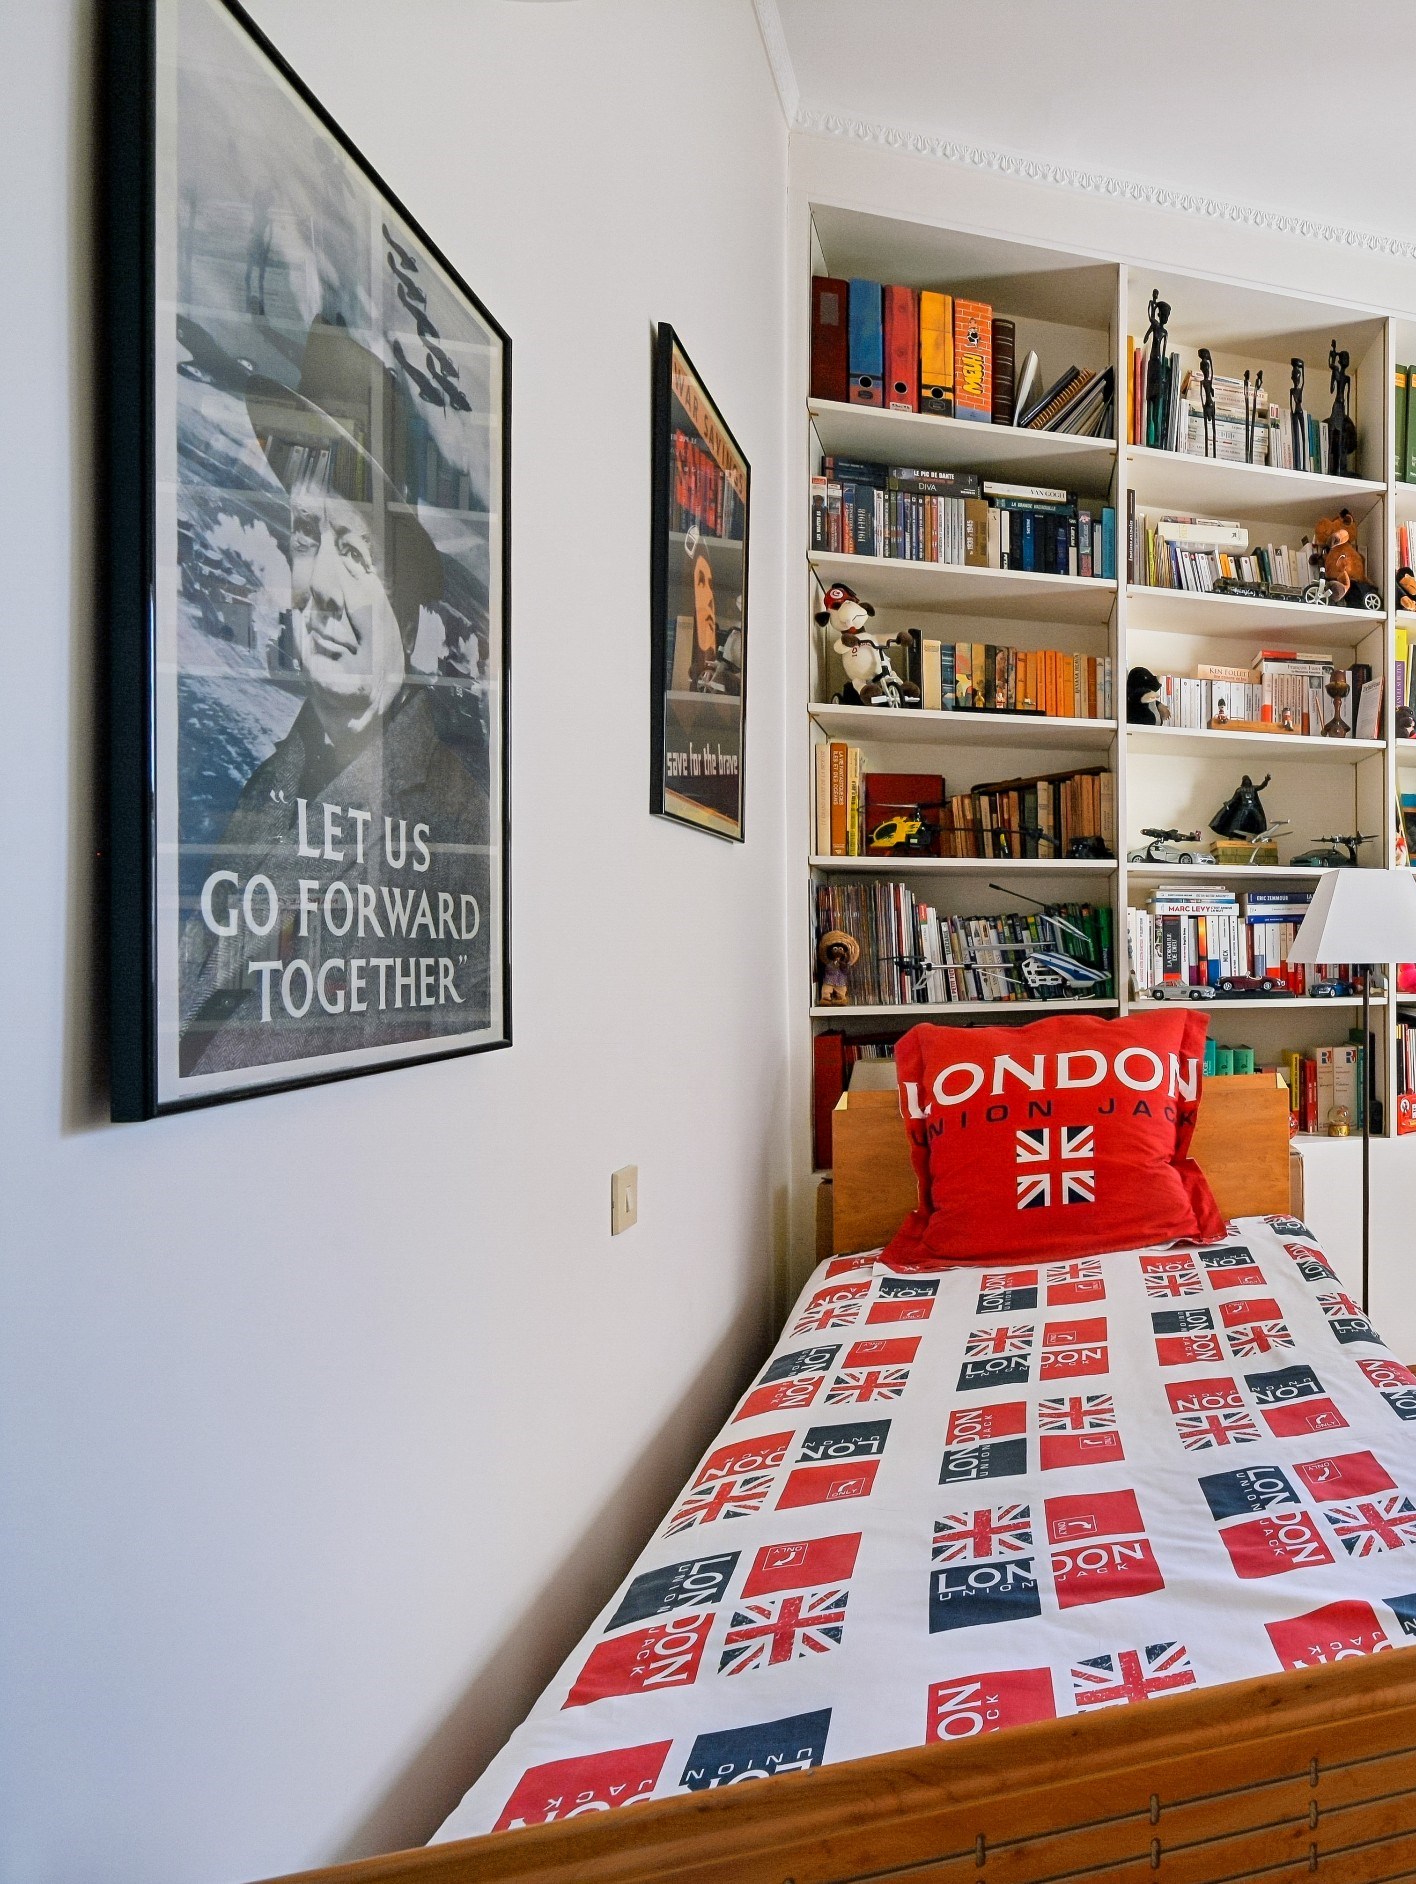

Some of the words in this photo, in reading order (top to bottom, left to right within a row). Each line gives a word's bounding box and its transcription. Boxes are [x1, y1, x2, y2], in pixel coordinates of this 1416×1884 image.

[674, 362, 698, 423] WAR
[918, 482, 937, 492] DIVA
[938, 472, 955, 480] DANTE
[1030, 488, 1044, 496] VAN
[1044, 490, 1065, 498] GOGH
[966, 520, 974, 535] 1945
[966, 538, 974, 550] 1939
[1209, 668, 1224, 676] KEN
[1224, 668, 1250, 678] FOLLETT
[667, 752, 688, 776] save
[690, 742, 702, 776] for
[703, 743, 716, 776] the
[718, 744, 738, 776] brave
[385, 814, 432, 873] US
[200, 869, 280, 938] GO
[298, 879, 481, 941] FORWARD
[1167, 959, 1172, 968] LA
[1172, 953, 1178, 961] DE
[903, 1047, 1199, 1119] LONDON
[911, 1100, 1052, 1148] UNION
[1097, 1098, 1196, 1127] JACK
[656, 1564, 692, 1614] UNION
[939, 1581, 1034, 1601] UNION
[1058, 1563, 1129, 1582] JACK
[629, 1627, 658, 1678] JACK
[1308, 1630, 1382, 1655] JACK
[686, 1747, 813, 1782] UNION
[544, 1778, 654, 1812] JACK
